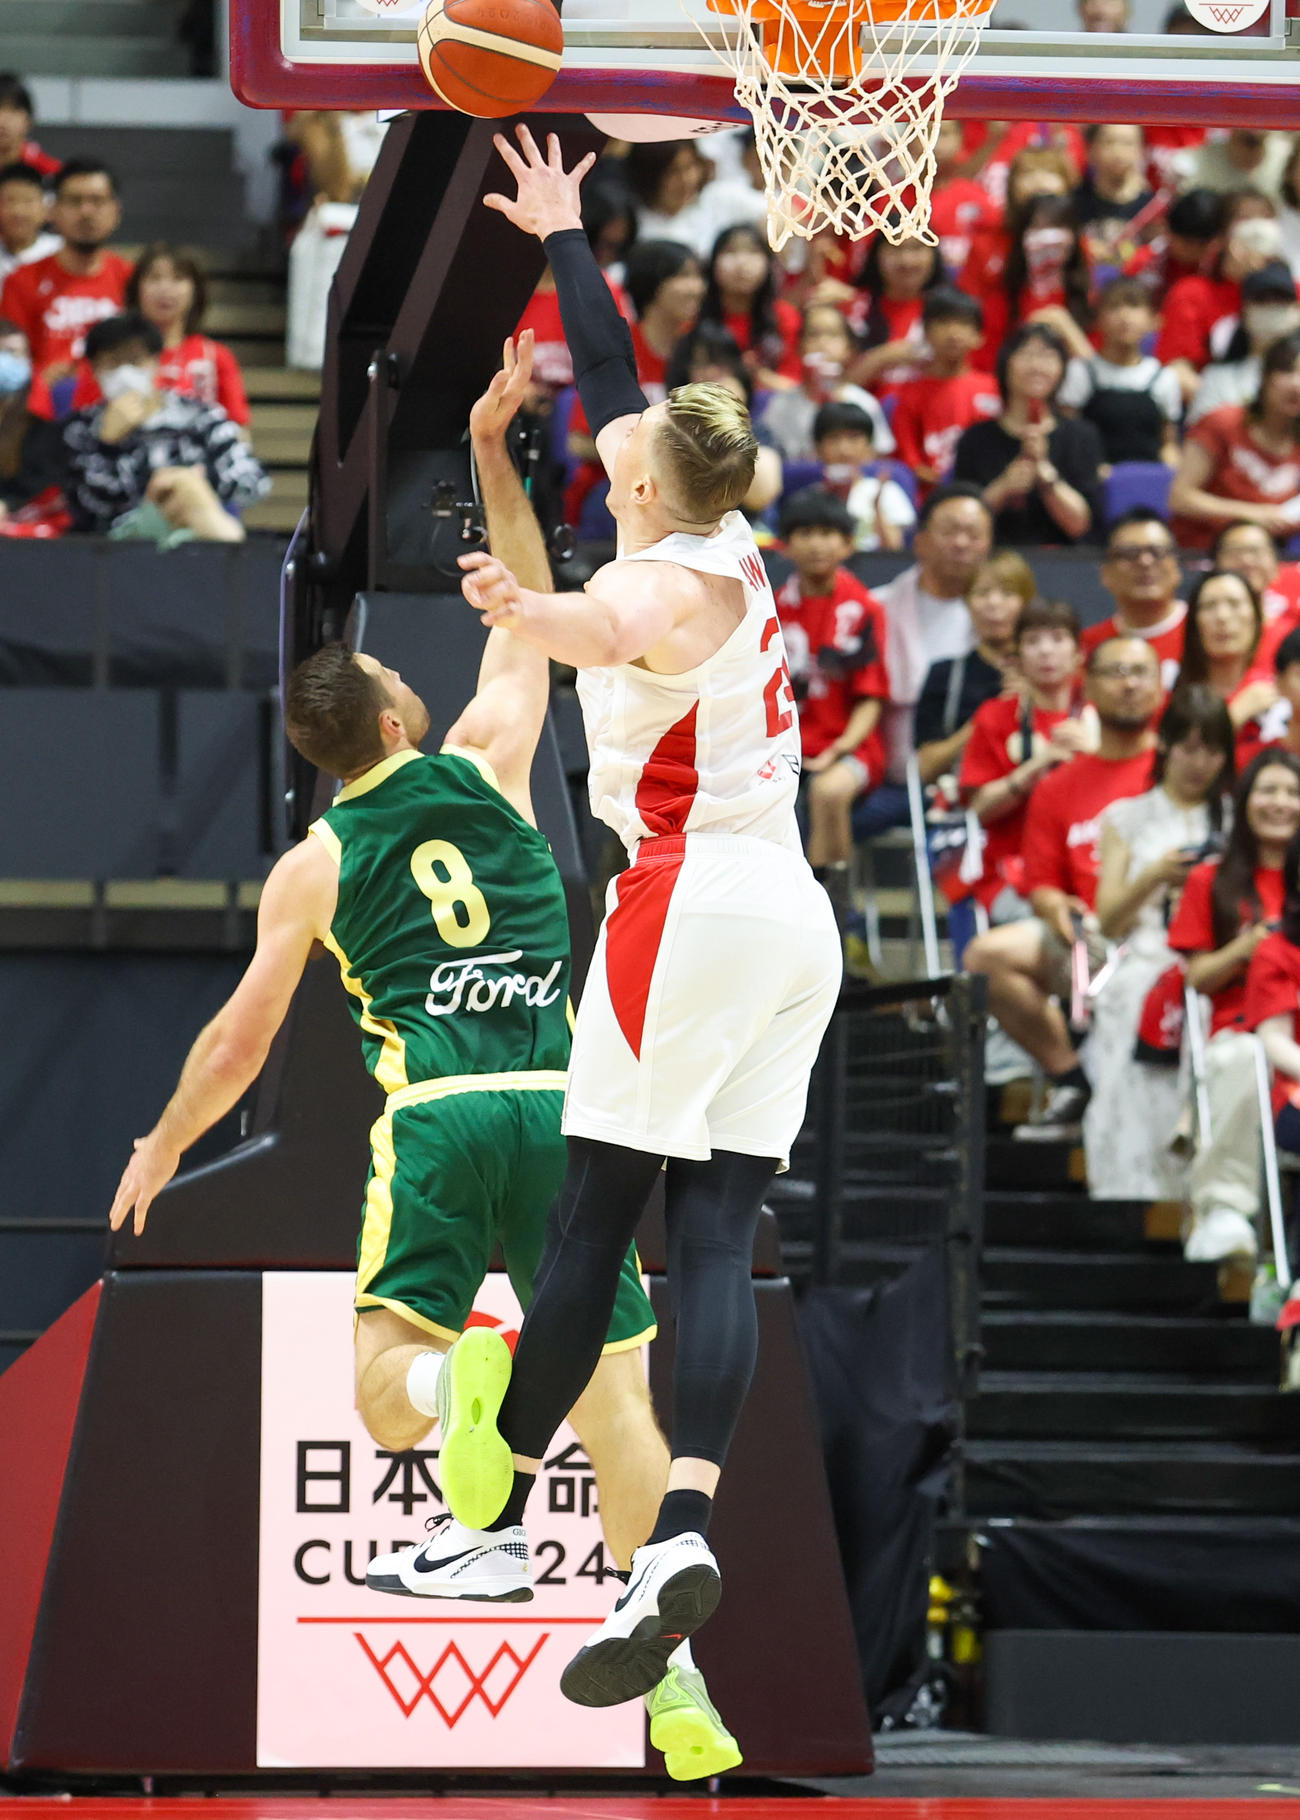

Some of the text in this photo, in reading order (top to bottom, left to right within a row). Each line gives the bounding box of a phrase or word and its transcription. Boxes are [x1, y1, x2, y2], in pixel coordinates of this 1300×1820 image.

[410, 839, 491, 948] 8
[425, 950, 562, 1016] Ford
[296, 1440, 598, 1517] 日本命
[534, 1540, 608, 1585] 24
